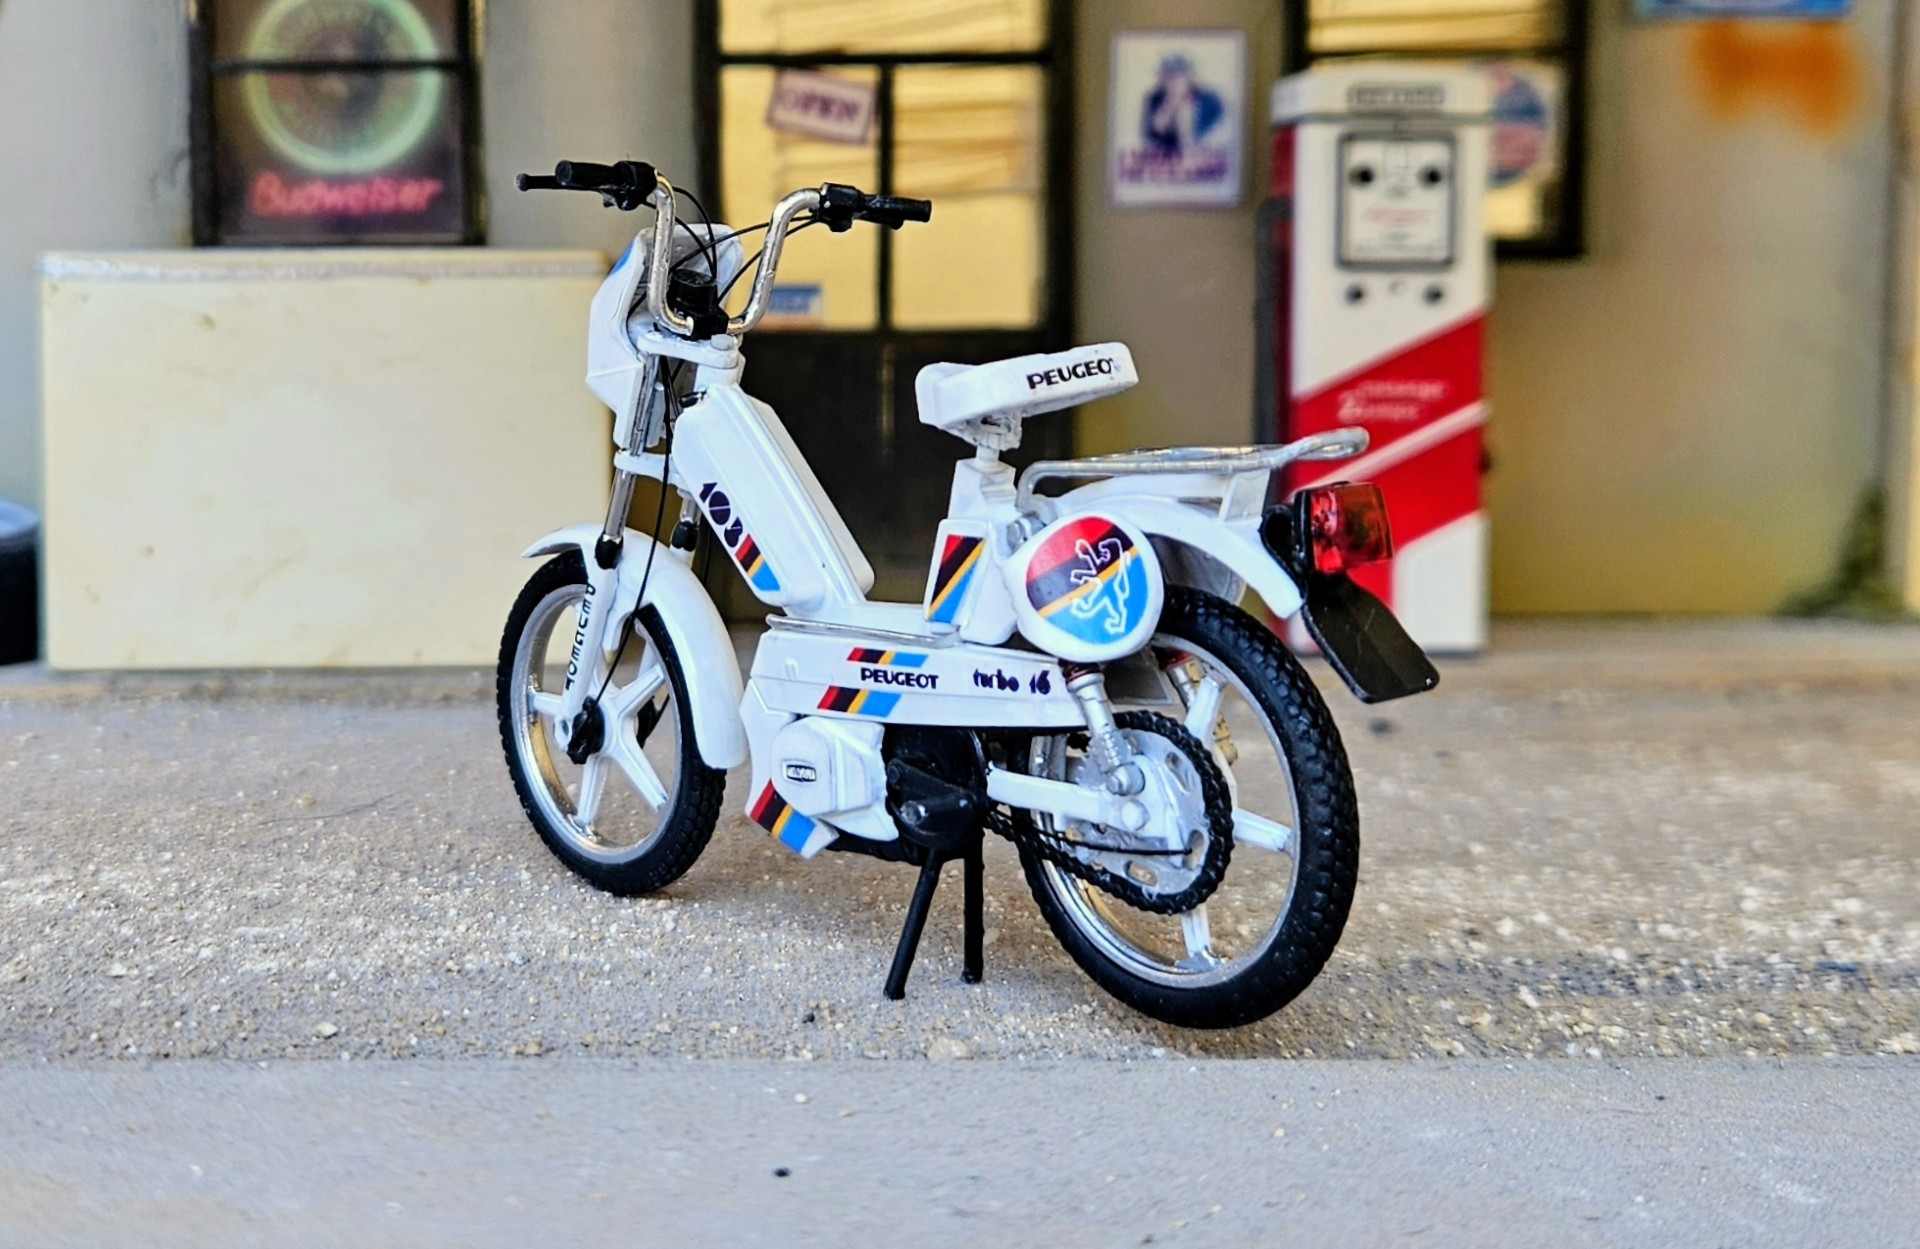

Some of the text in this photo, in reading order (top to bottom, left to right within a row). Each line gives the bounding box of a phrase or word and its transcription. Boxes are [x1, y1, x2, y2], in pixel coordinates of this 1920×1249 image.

[251, 171, 443, 219] Budweiser
[565, 582, 596, 691] PEUGEOT
[861, 667, 939, 690] PEUGEOT
[973, 668, 1051, 695] turbo 16
